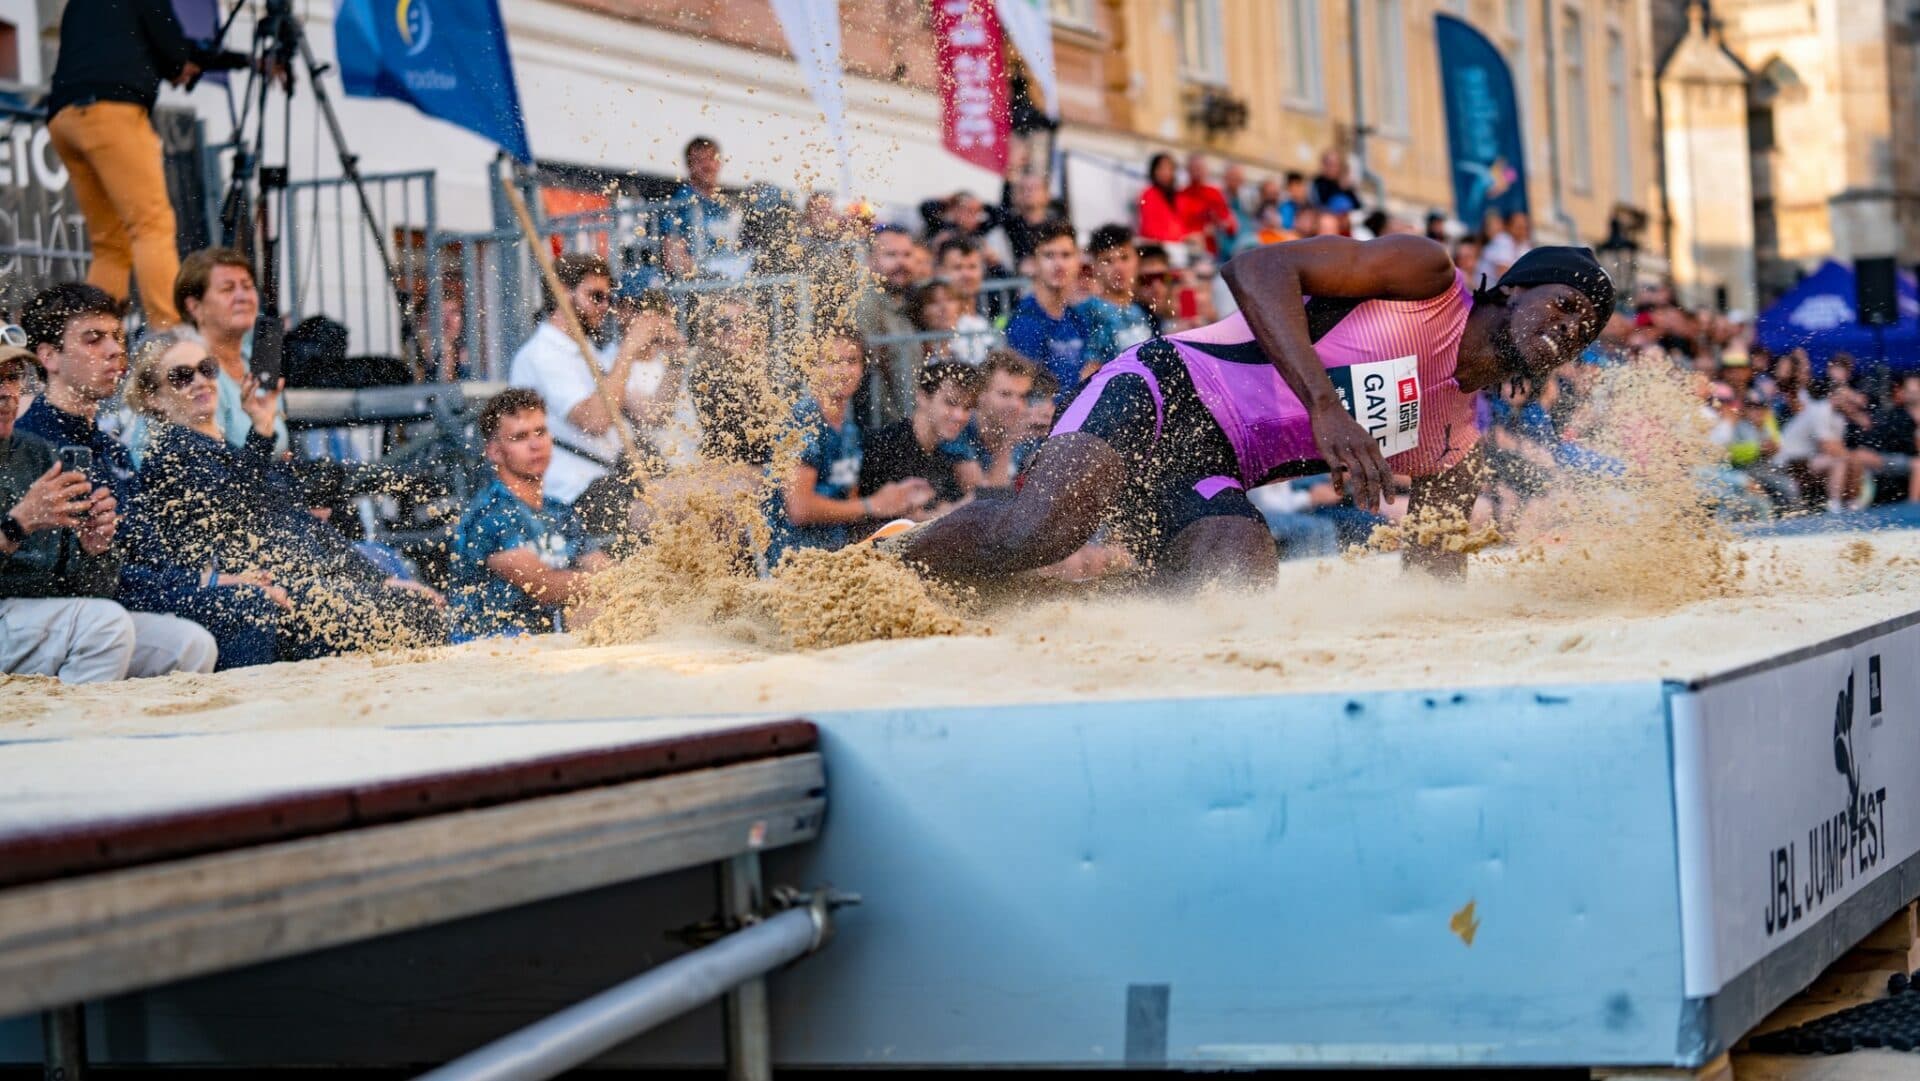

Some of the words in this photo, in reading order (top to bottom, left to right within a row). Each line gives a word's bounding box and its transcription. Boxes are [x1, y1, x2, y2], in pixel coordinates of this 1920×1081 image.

[1399, 403, 1410, 432] LISTEN
[1765, 840, 1802, 937] JBL
[1804, 786, 1886, 912] JUMPFEST
